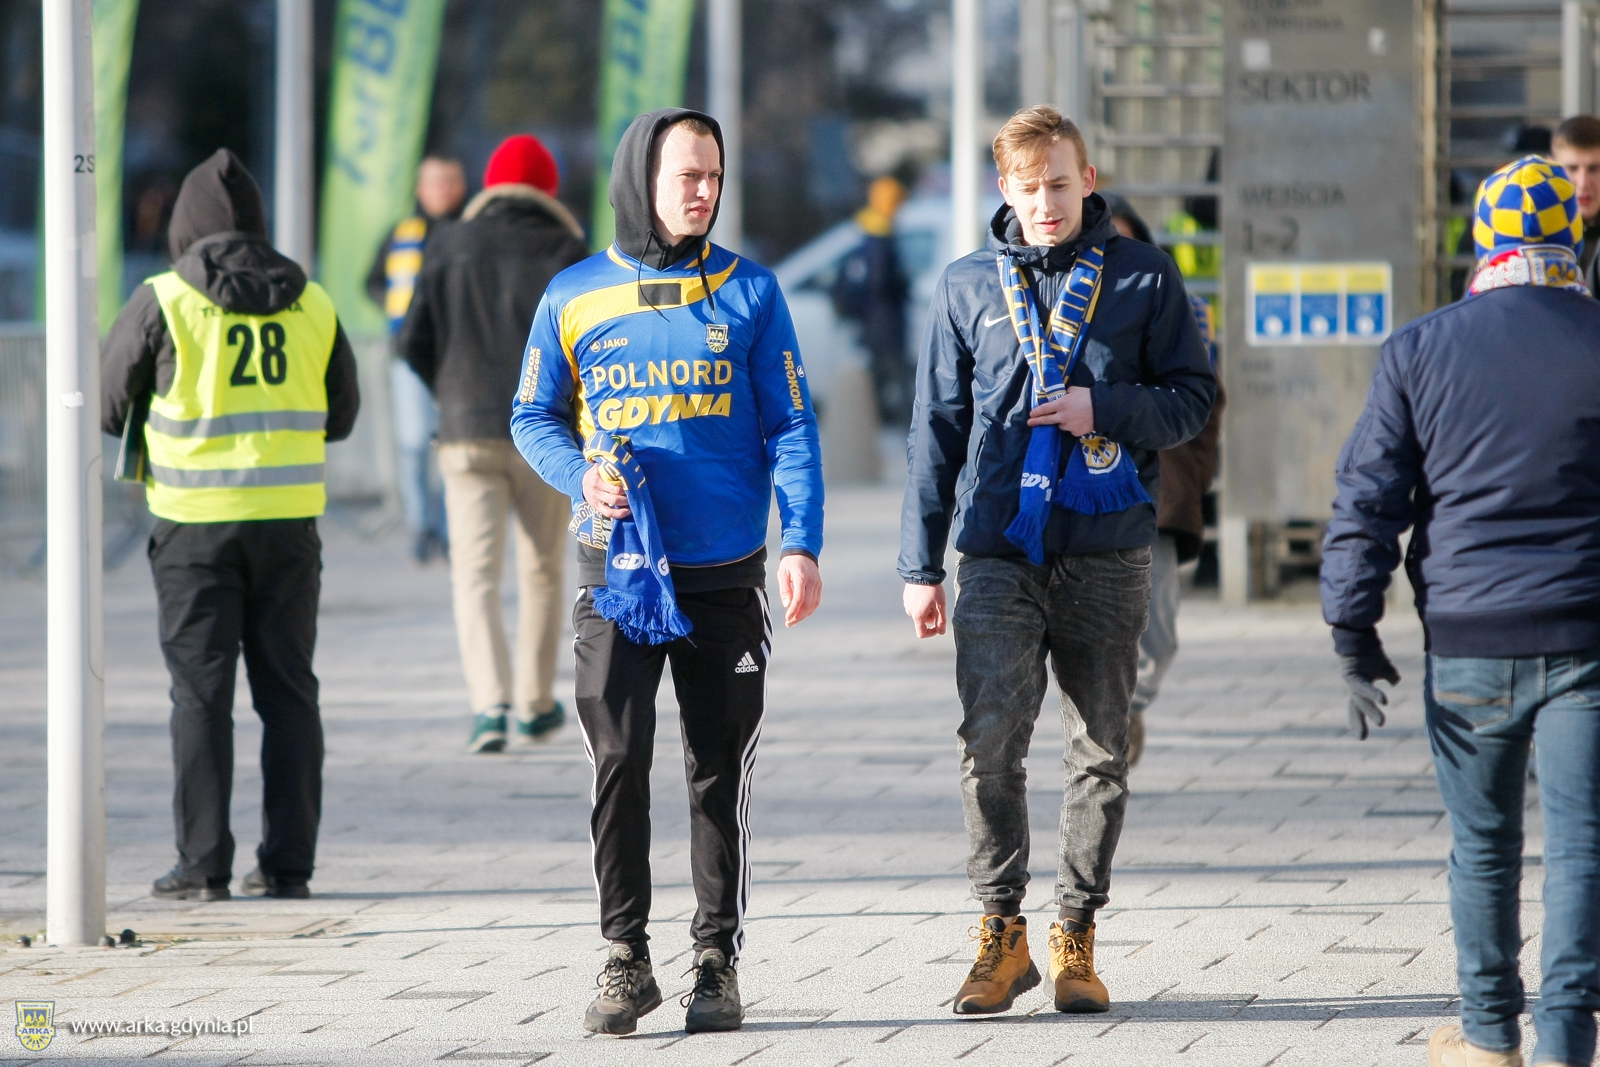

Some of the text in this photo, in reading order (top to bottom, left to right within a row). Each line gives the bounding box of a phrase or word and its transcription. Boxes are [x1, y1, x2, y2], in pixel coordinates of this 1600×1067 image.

[1239, 71, 1372, 103] SEKTOR
[227, 321, 287, 387] 28
[603, 337, 629, 349] JAKO
[526, 345, 537, 376] BOX
[591, 359, 733, 391] POLNORD
[782, 351, 804, 410] PROKOM
[597, 393, 732, 431] GDYNIA
[734, 664, 760, 674] adidas
